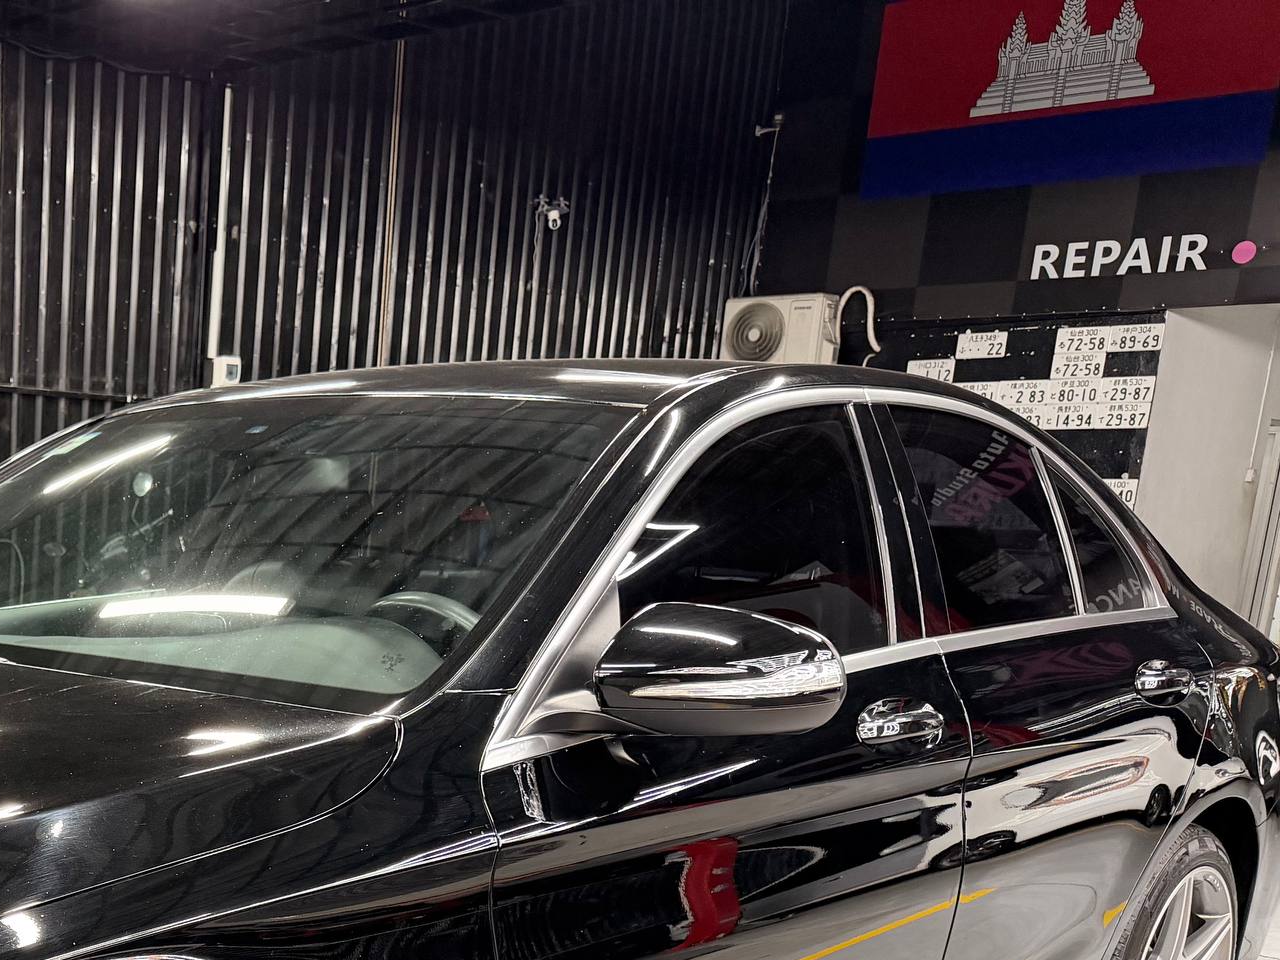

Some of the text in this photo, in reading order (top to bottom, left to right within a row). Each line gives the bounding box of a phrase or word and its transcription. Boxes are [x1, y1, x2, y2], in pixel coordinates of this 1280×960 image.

[1029, 233, 1209, 281] REPAIR
[1066, 337, 1106, 352] 72-58
[1119, 334, 1160, 350] 89-69
[1062, 363, 1101, 378] 72-58
[1058, 388, 1097, 402] 80-10
[1110, 386, 1151, 402] 29-87
[1055, 413, 1092, 428] 14-94
[1106, 412, 1146, 428] 29-87
